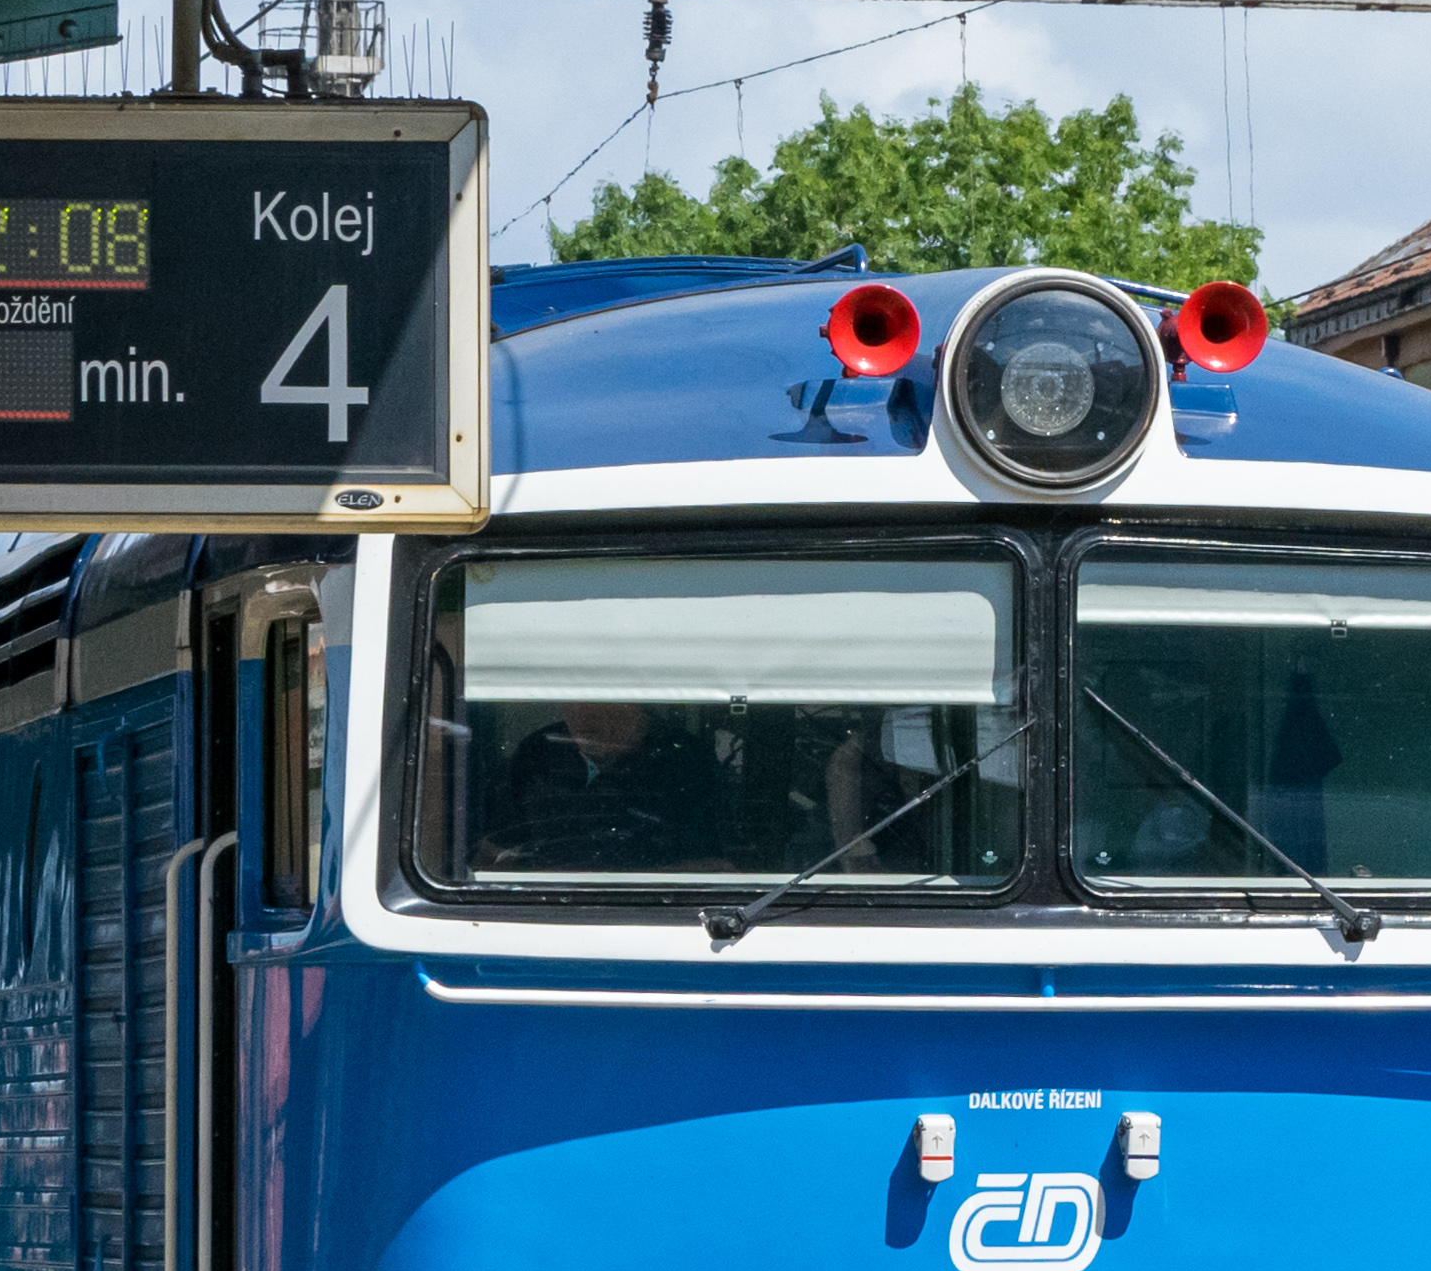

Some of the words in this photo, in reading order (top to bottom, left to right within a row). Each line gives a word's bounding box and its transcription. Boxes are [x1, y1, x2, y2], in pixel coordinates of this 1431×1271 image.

[254, 191, 374, 255] Kolej
[80, 347, 185, 403] min.
[260, 284, 369, 442] 4
[337, 494, 381, 506] ELEN
[969, 1089, 1044, 1109] DÁLKOVÉ
[1049, 1089, 1102, 1109] ŘÍZENÍ
